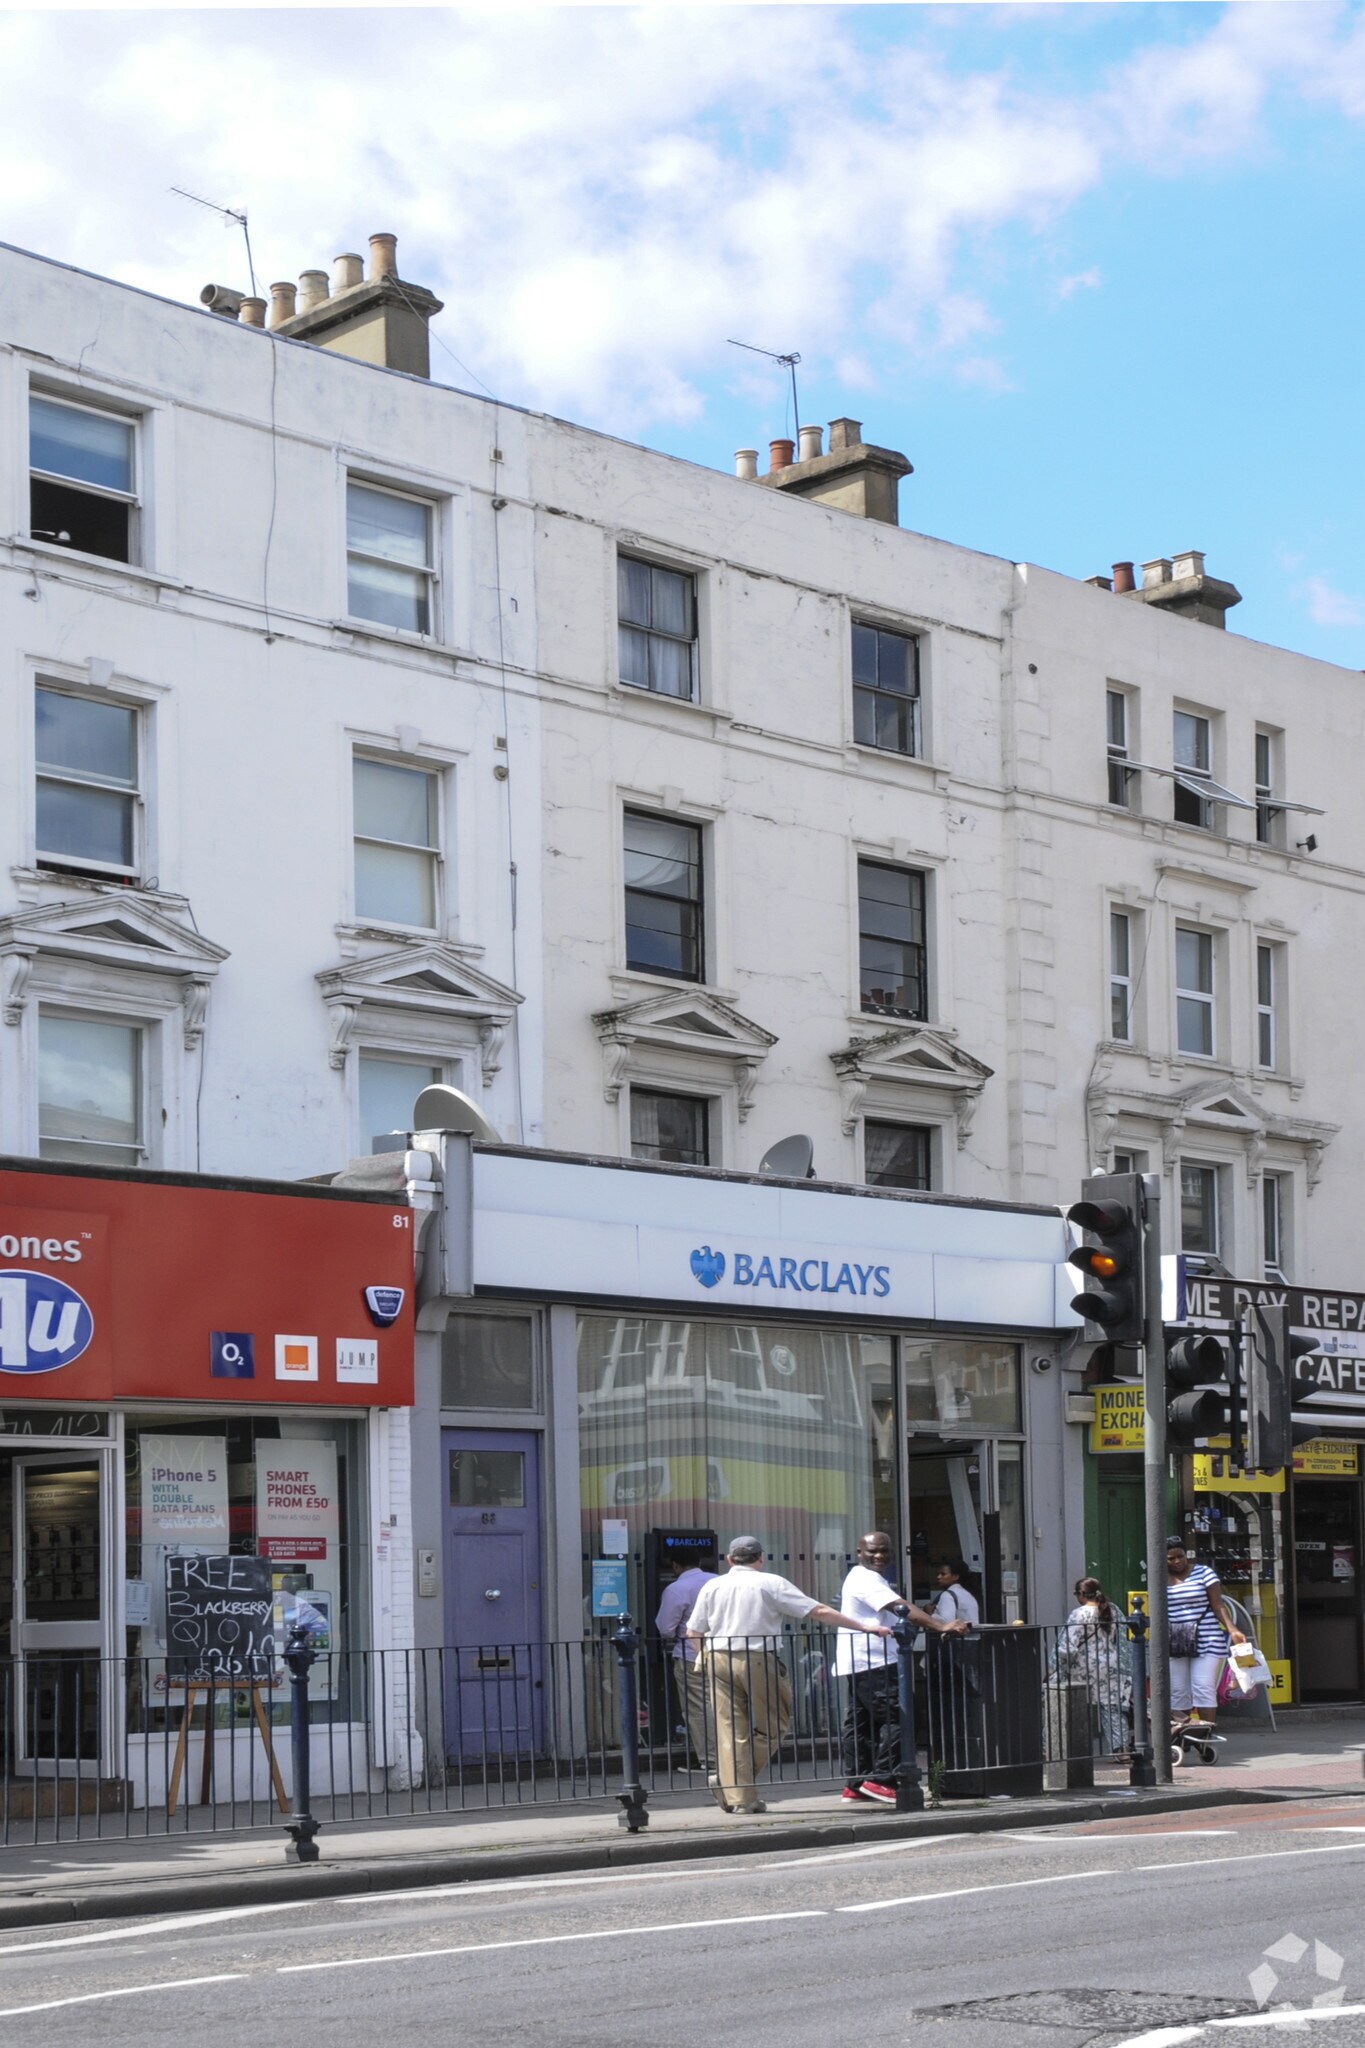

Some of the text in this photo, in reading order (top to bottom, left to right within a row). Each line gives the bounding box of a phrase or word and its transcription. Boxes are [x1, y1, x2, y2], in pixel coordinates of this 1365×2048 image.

[392, 1215, 409, 1229] 81
[733, 1253, 890, 1297] BARCLAYS
[152, 1468, 217, 1482] iPhone 5
[266, 1471, 309, 1482] SMART
[152, 1484, 180, 1493] WITH
[267, 1484, 317, 1495] PHONES
[152, 1494, 194, 1503] DOUBLE
[267, 1497, 303, 1508] FROM
[153, 1504, 216, 1514] DATA PLANS
[674, 1537, 712, 1546] BARCLAYS
[166, 1555, 254, 1591] FREE
[167, 1591, 273, 1625] BLACKBERRY
